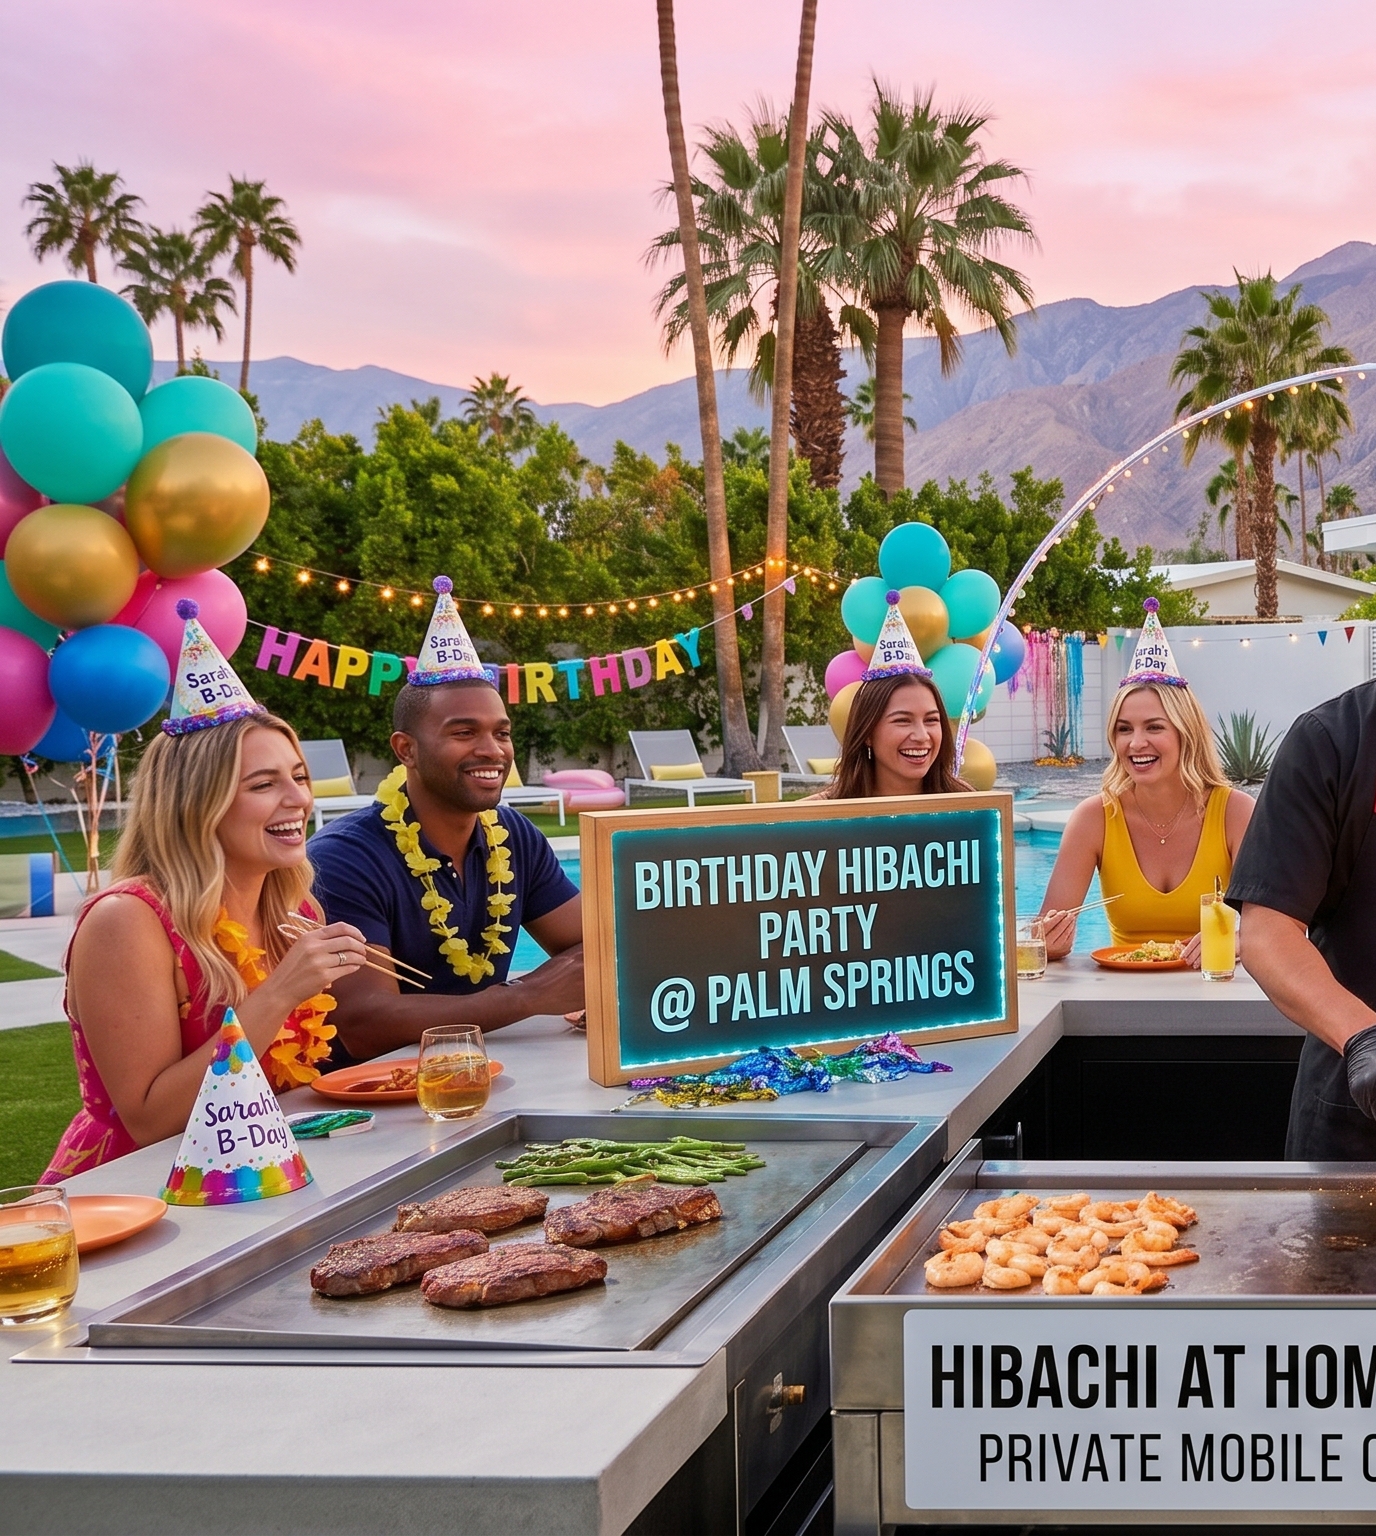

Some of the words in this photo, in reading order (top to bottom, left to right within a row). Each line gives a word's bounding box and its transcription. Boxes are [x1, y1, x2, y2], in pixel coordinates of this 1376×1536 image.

[255, 625, 418, 696] HAPP
[635, 850, 826, 910] BIRTHDAY
[838, 839, 981, 895] HIBACHI
[759, 903, 878, 959] PARTY
[650, 977, 696, 1032] @
[708, 966, 811, 1024] PALM
[823, 950, 974, 1010] SPRINGS
[217, 1124, 287, 1155] B-Day
[932, 1345, 1156, 1408] HIBACHI
[1178, 1345, 1245, 1408] AT
[980, 1434, 1161, 1482] PRIVATE
[1182, 1434, 1342, 1482] MOBILE
